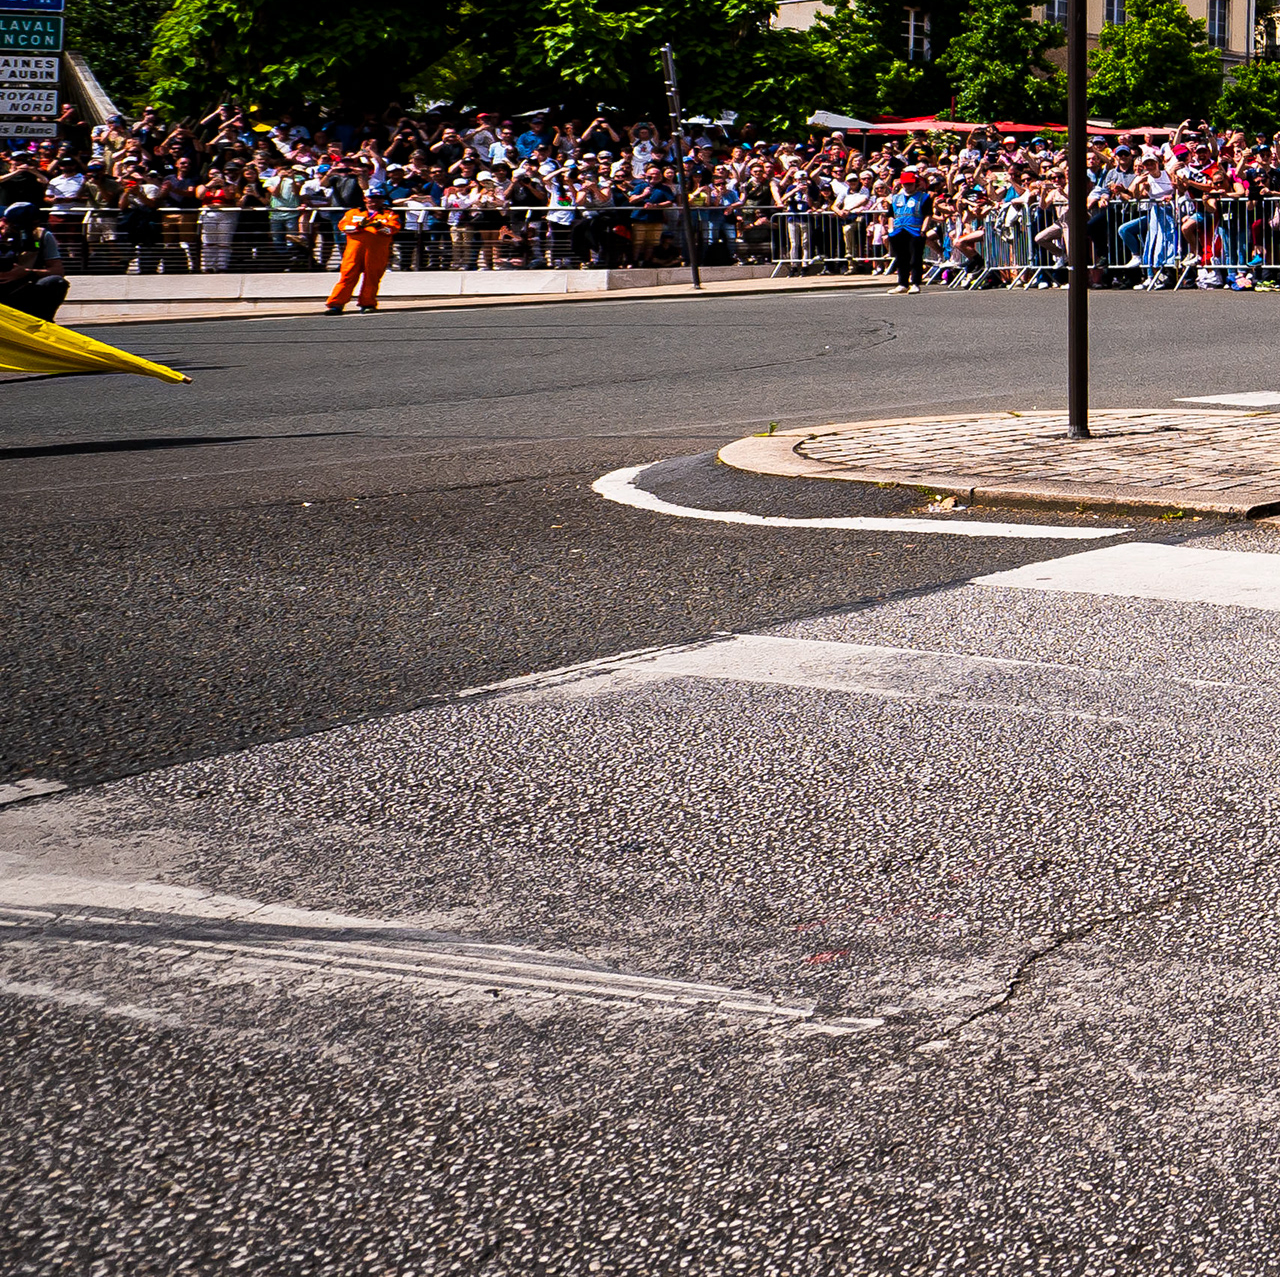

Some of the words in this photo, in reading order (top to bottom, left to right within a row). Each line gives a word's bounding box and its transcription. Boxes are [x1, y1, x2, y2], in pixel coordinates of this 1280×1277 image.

[0, 19, 55, 33] LAVAL
[3, 33, 55, 46] NÇON
[1, 58, 55, 69] AINES
[8, 69, 55, 80] AUBIN
[0, 91, 56, 102] ROYALE
[9, 102, 54, 112] NORD
[14, 125, 54, 135] Blanc
